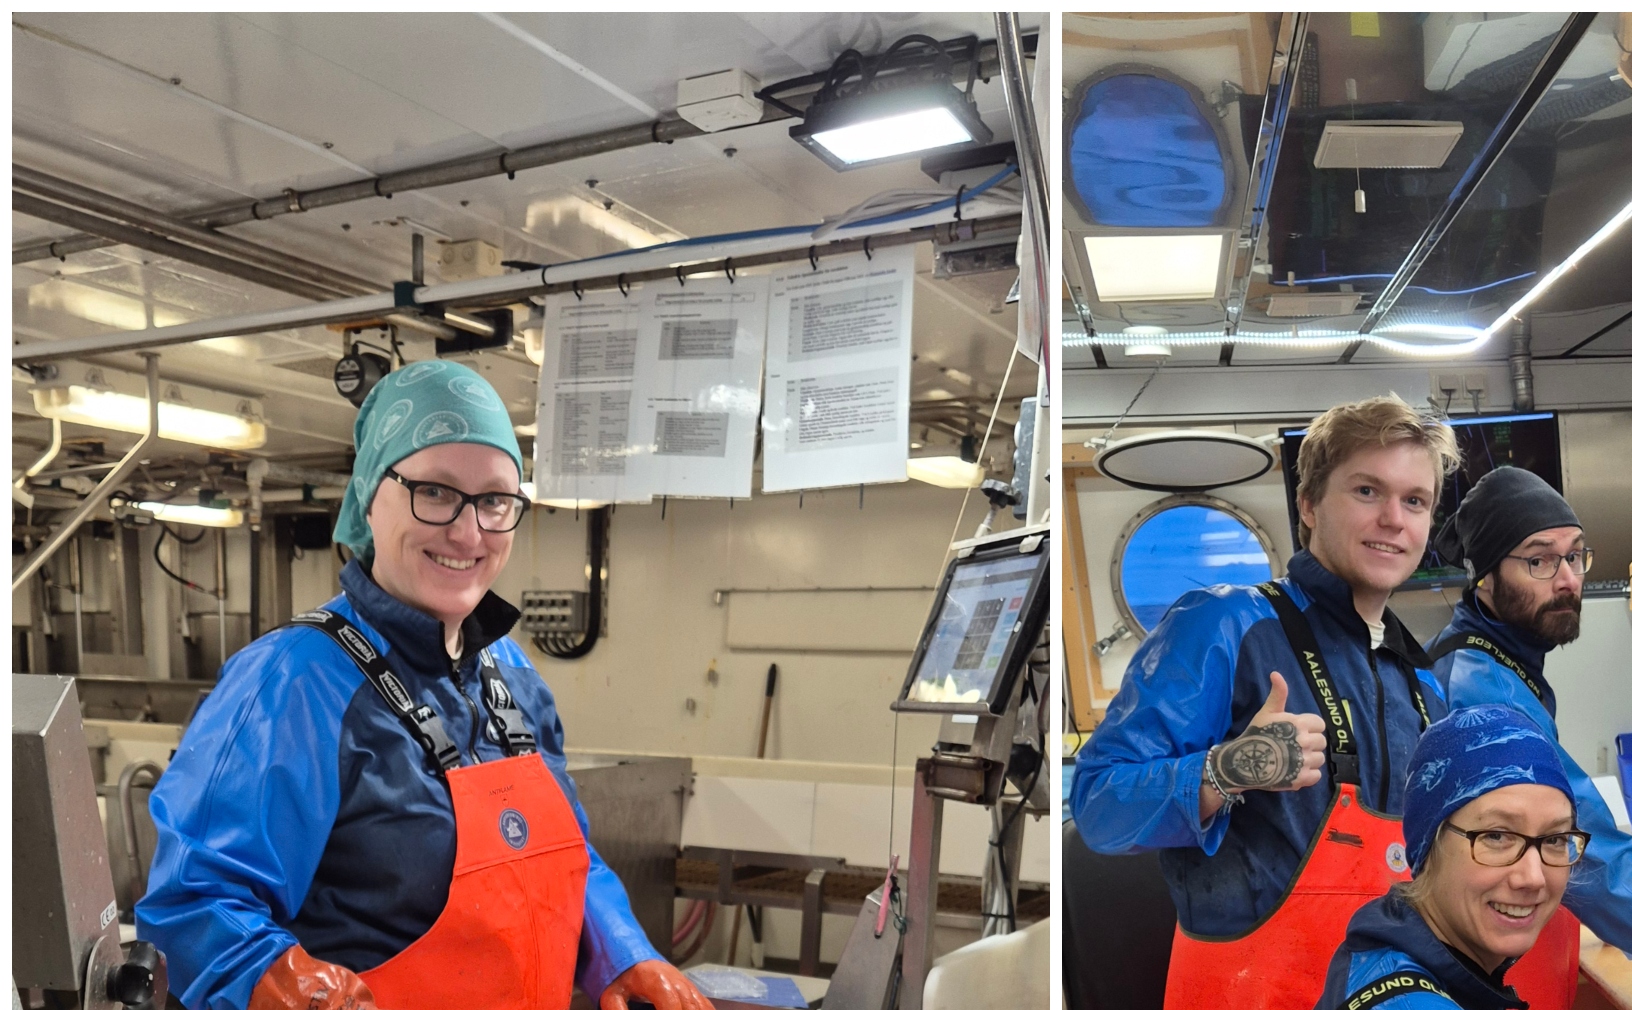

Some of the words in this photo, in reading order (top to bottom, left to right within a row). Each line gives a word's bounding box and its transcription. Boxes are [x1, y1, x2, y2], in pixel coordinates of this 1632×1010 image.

[342, 628, 374, 661] VICTORIA
[1466, 636, 1527, 679] OLJEKLEDE
[382, 673, 411, 710] VICTORIA
[1303, 650, 1344, 727] AALESUND
